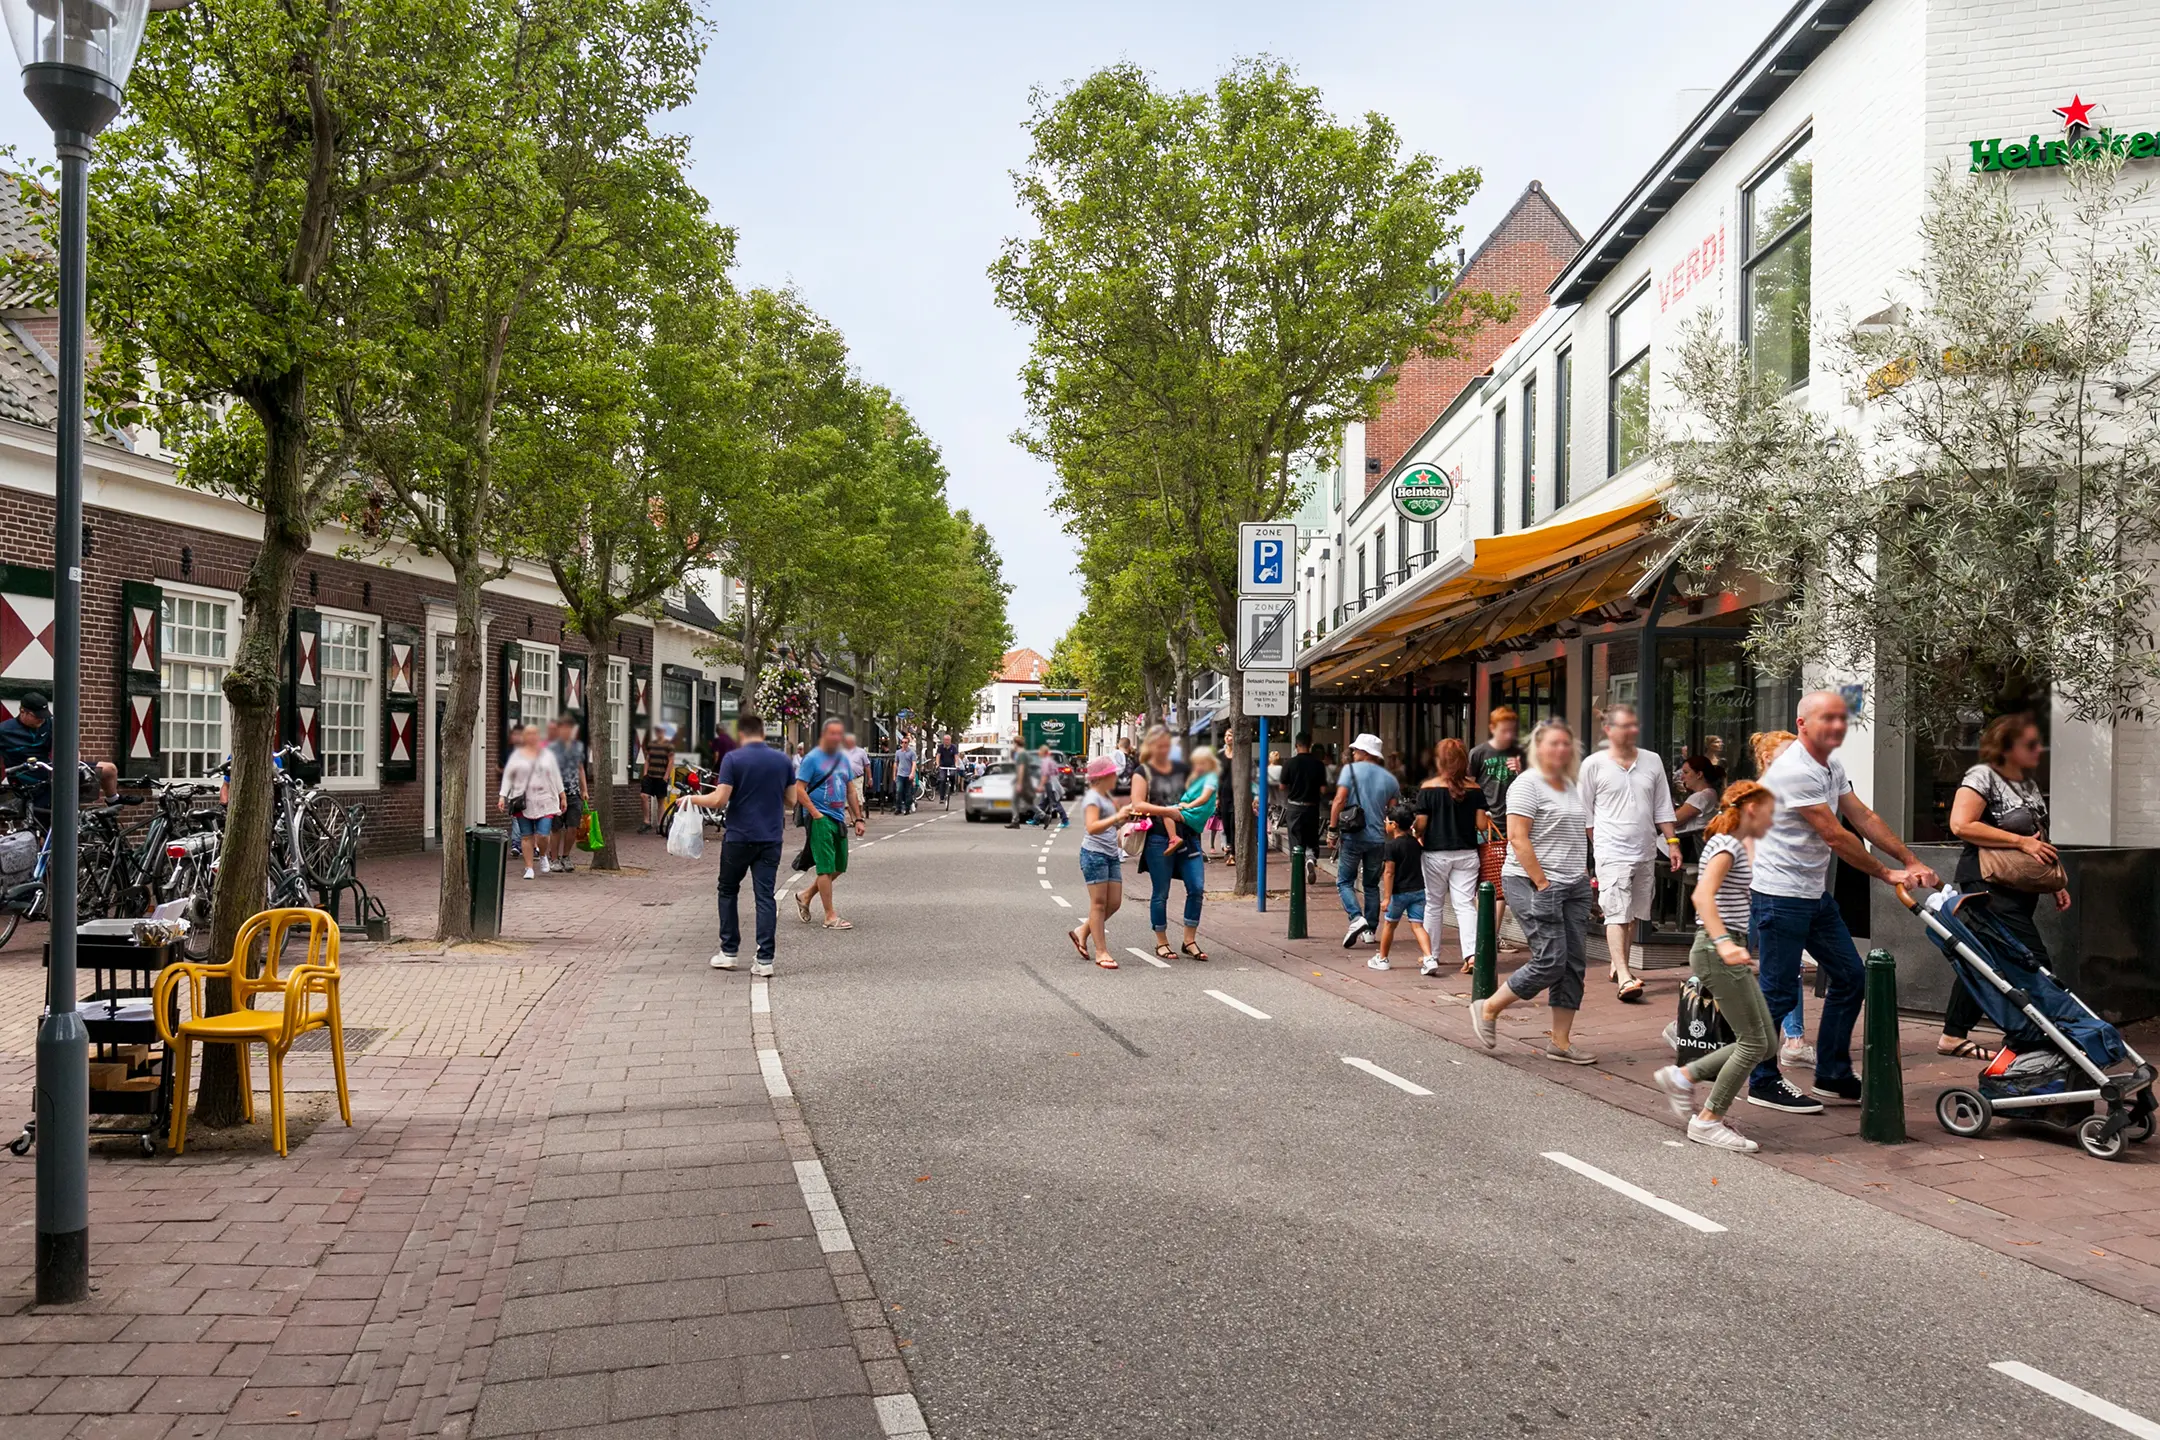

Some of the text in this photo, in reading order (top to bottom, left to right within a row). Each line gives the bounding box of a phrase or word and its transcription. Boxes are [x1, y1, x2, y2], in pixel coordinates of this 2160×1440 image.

[1968, 127, 2160, 173] Heineke
[1658, 223, 1725, 314] VERDI
[1397, 487, 1448, 497] Heineken
[1260, 542, 1278, 566] P
